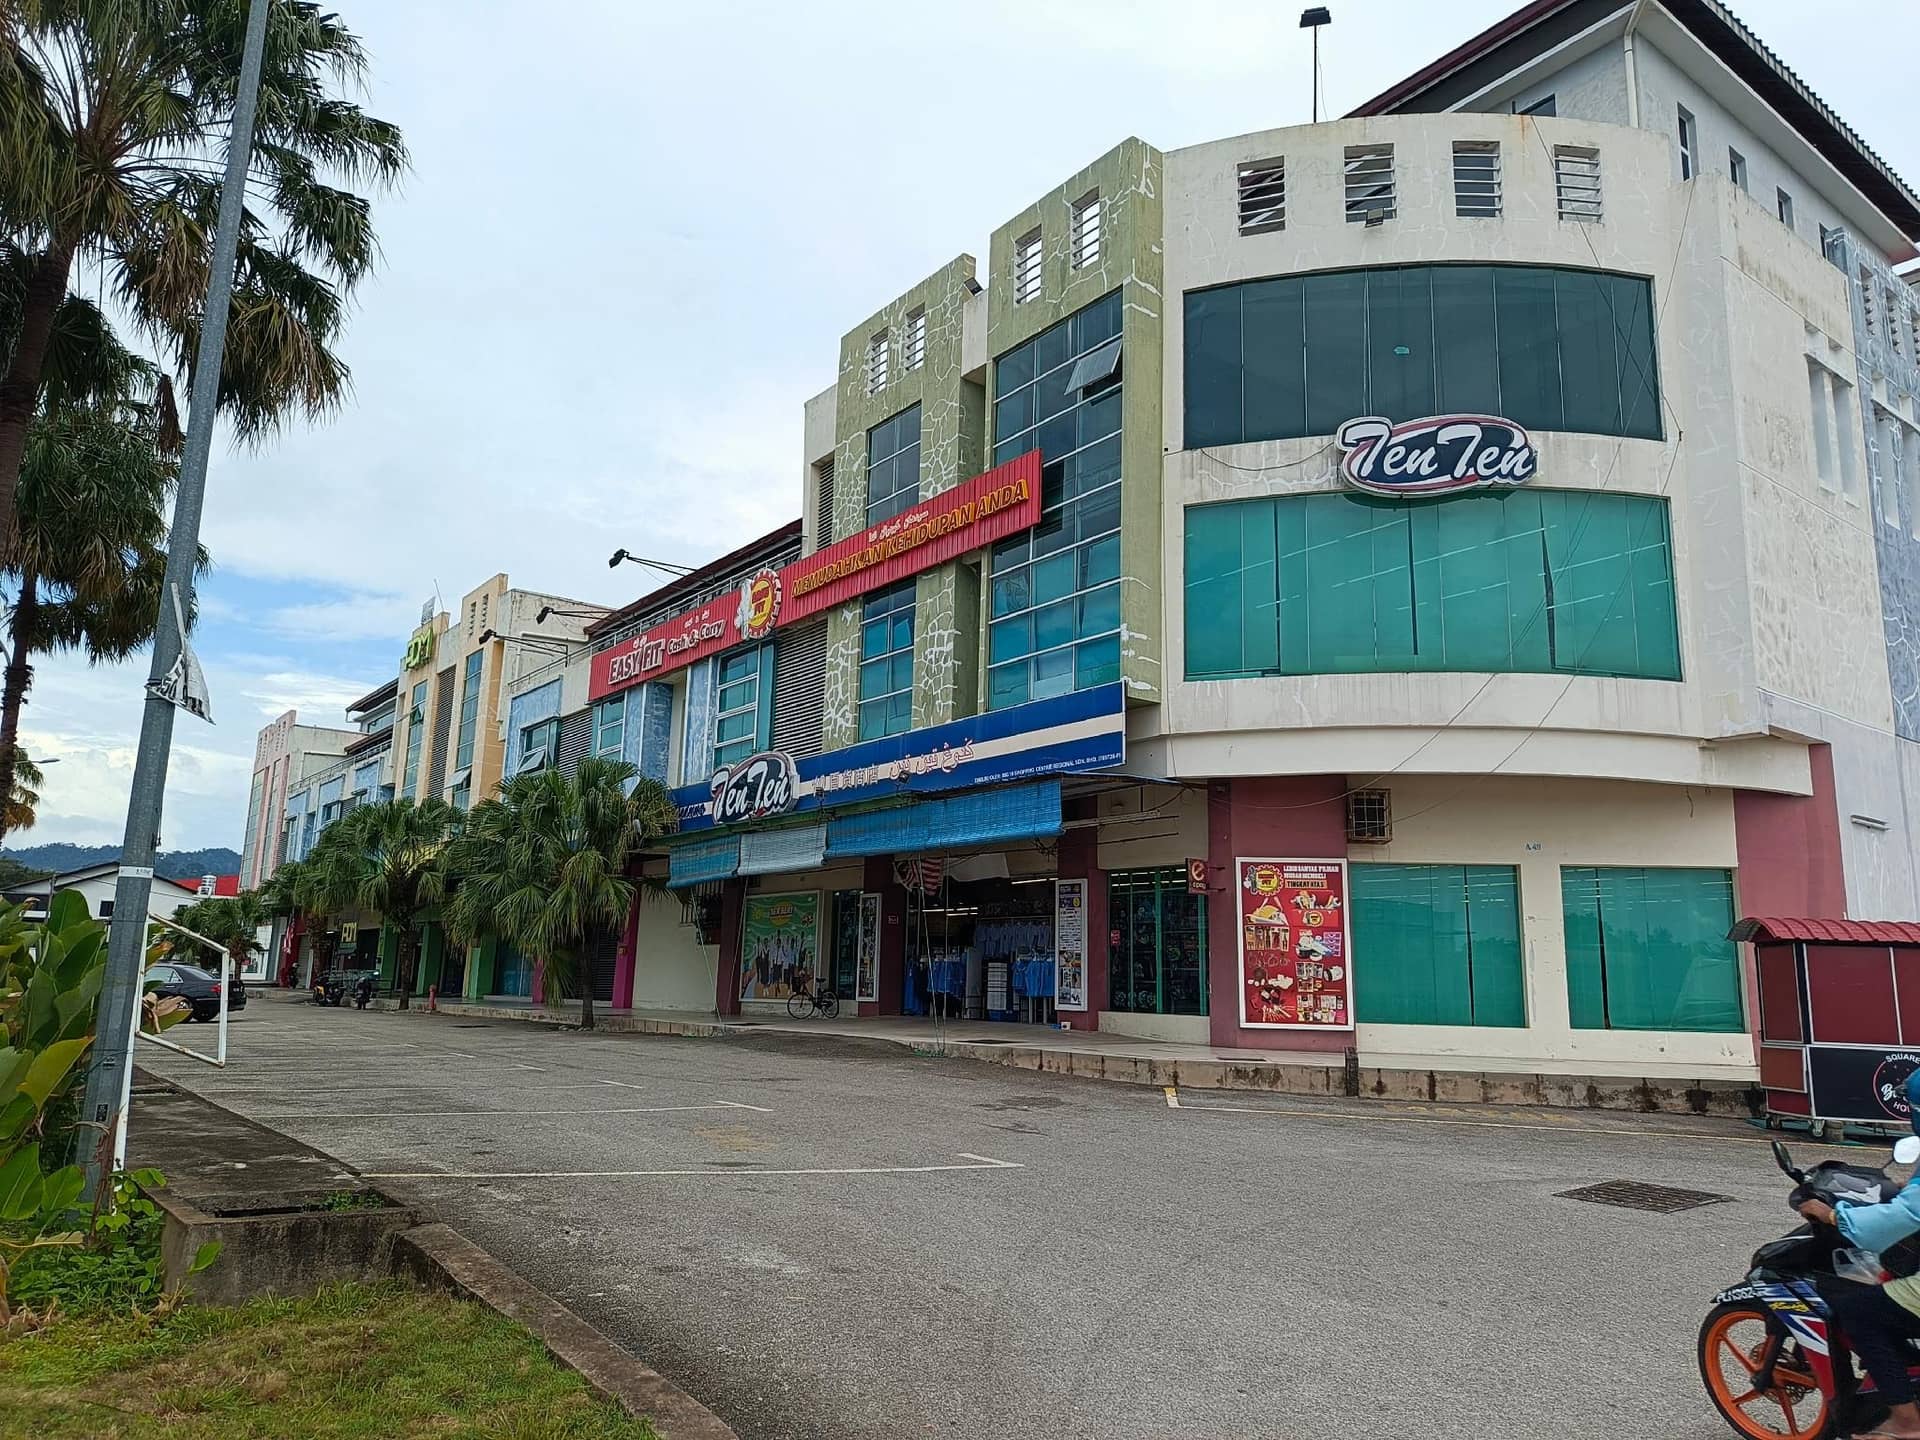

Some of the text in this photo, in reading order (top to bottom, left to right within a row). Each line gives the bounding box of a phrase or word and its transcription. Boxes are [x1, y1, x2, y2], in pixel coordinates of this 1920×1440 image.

[1343, 421, 1533, 478] Ten Ten
[791, 542, 886, 597] MEMUDAHKAN
[885, 501, 976, 559] KEHIDUPAN
[975, 478, 1030, 524] ANDA
[608, 648, 642, 685] EASY
[642, 639, 666, 672] FIT
[667, 634, 690, 655] Cash
[711, 770, 749, 820] Ten
[747, 760, 790, 813] Ten
[1885, 1052, 1920, 1064] SQUARE
